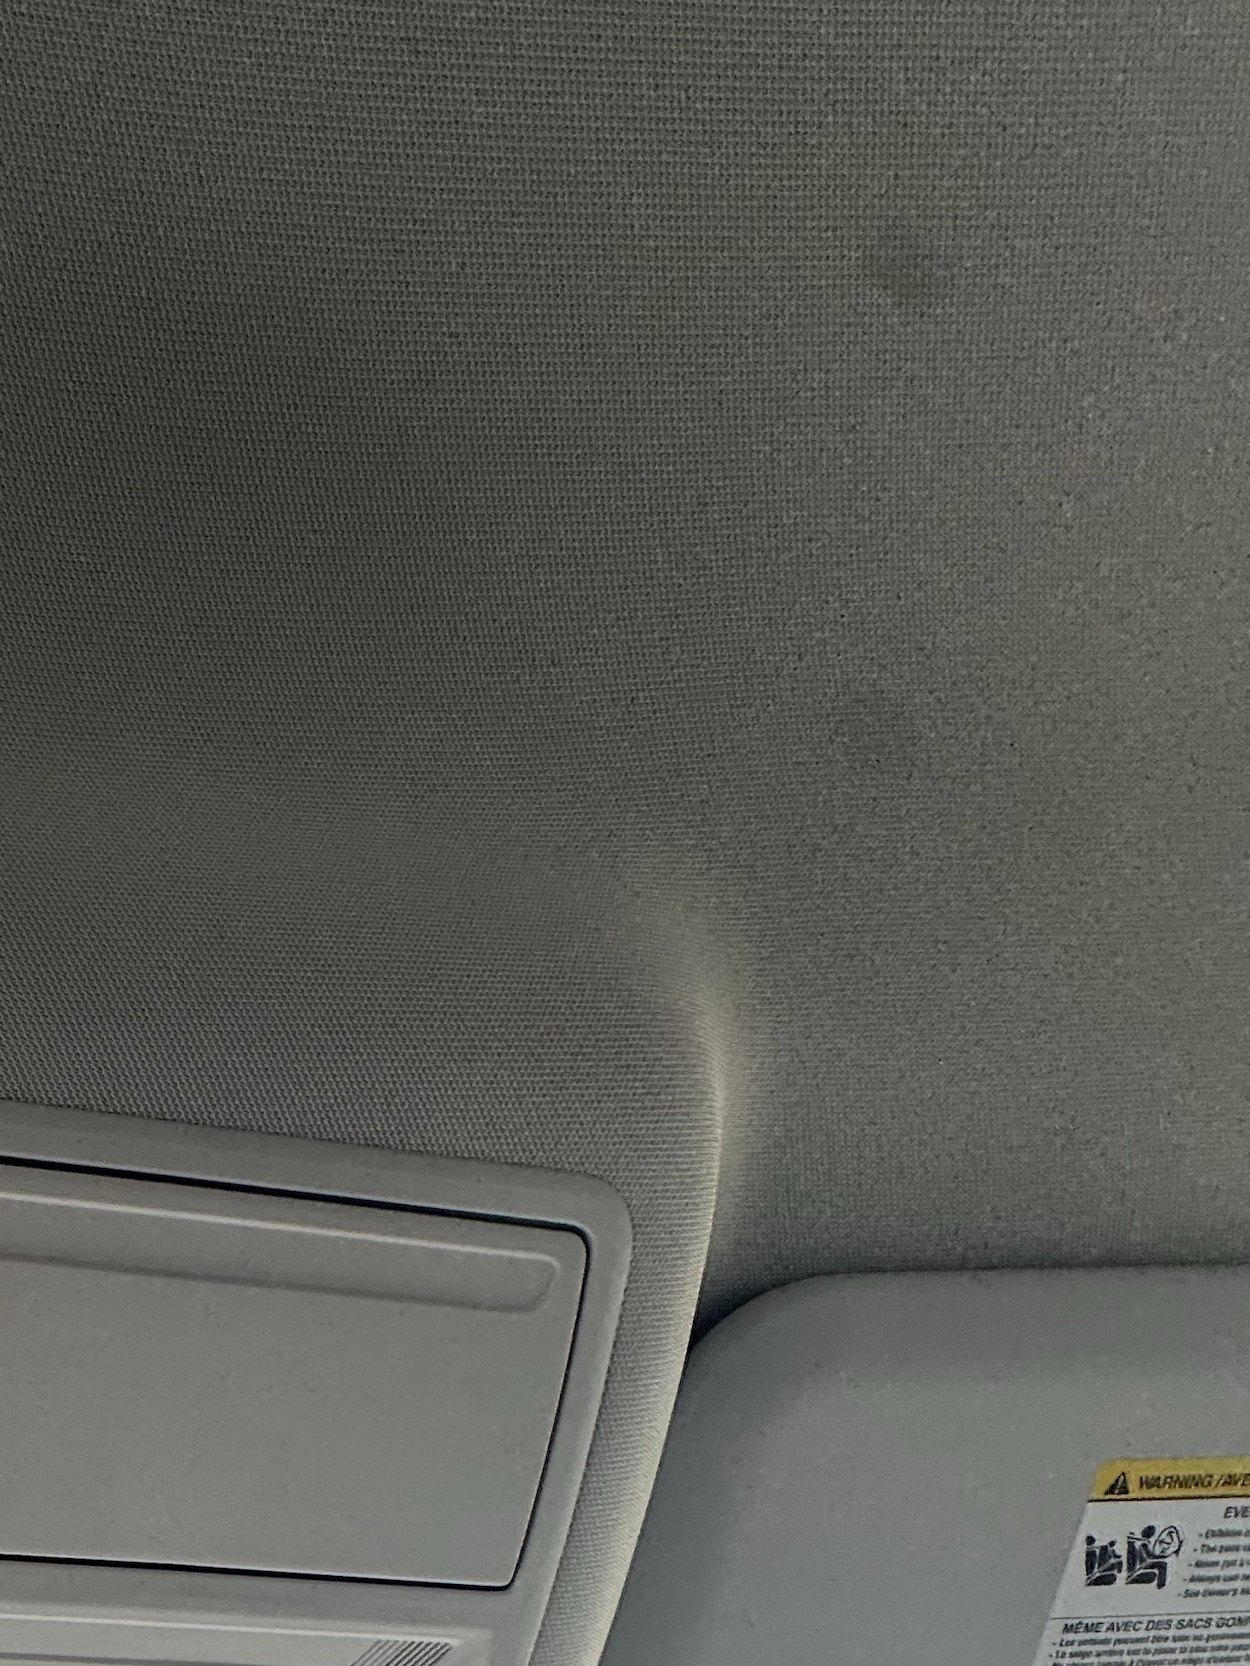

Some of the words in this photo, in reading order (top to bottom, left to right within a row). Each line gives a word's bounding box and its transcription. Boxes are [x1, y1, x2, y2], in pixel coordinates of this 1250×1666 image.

[1105, 1620, 1142, 1632] AVEC
[1145, 1619, 1172, 1631] DES
[1175, 1618, 1212, 1630] SACS
